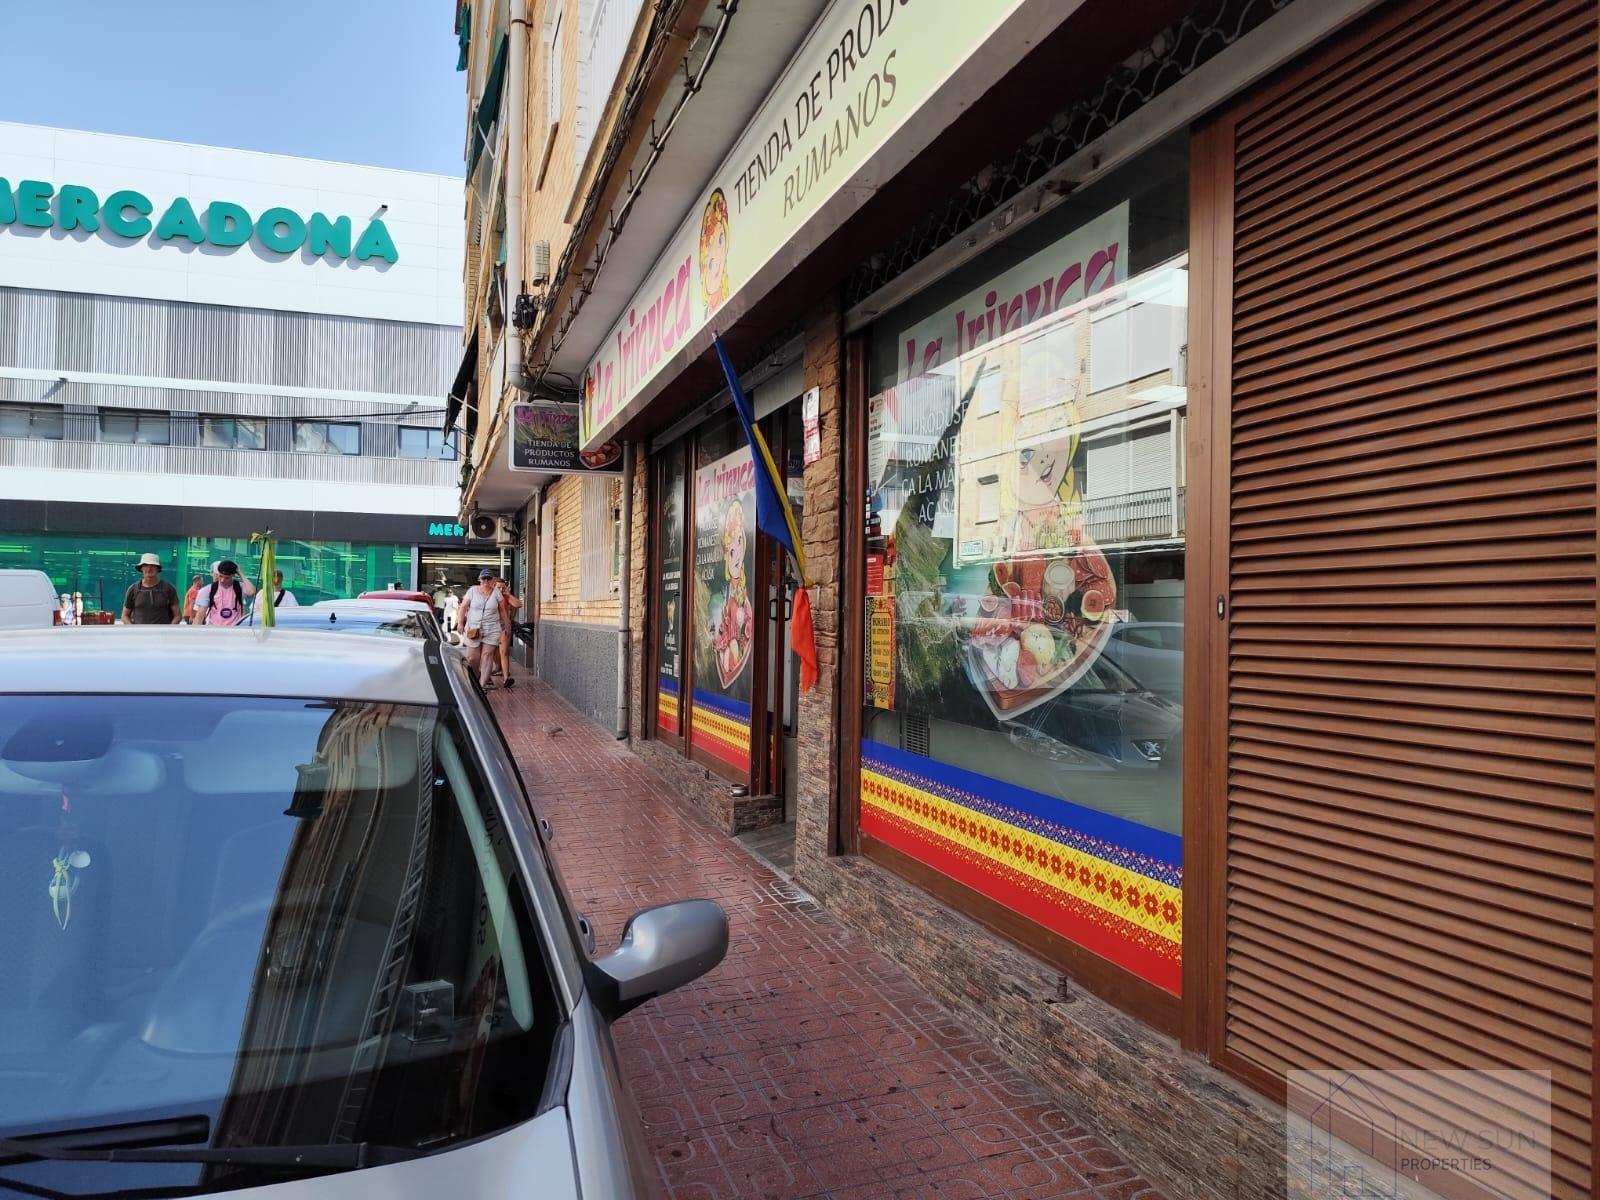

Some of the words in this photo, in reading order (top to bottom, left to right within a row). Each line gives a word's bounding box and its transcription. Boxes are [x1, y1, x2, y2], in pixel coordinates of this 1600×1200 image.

[734, 118, 793, 214] TIENDA
[795, 70, 823, 140] DE
[827, 0, 908, 101] PROD
[783, 49, 897, 218] RUMANOS
[528, 440, 558, 448] TIENDA
[560, 441, 571, 449] DE
[524, 449, 575, 458] PRODUCTOS
[528, 458, 571, 467] RUMANOS
